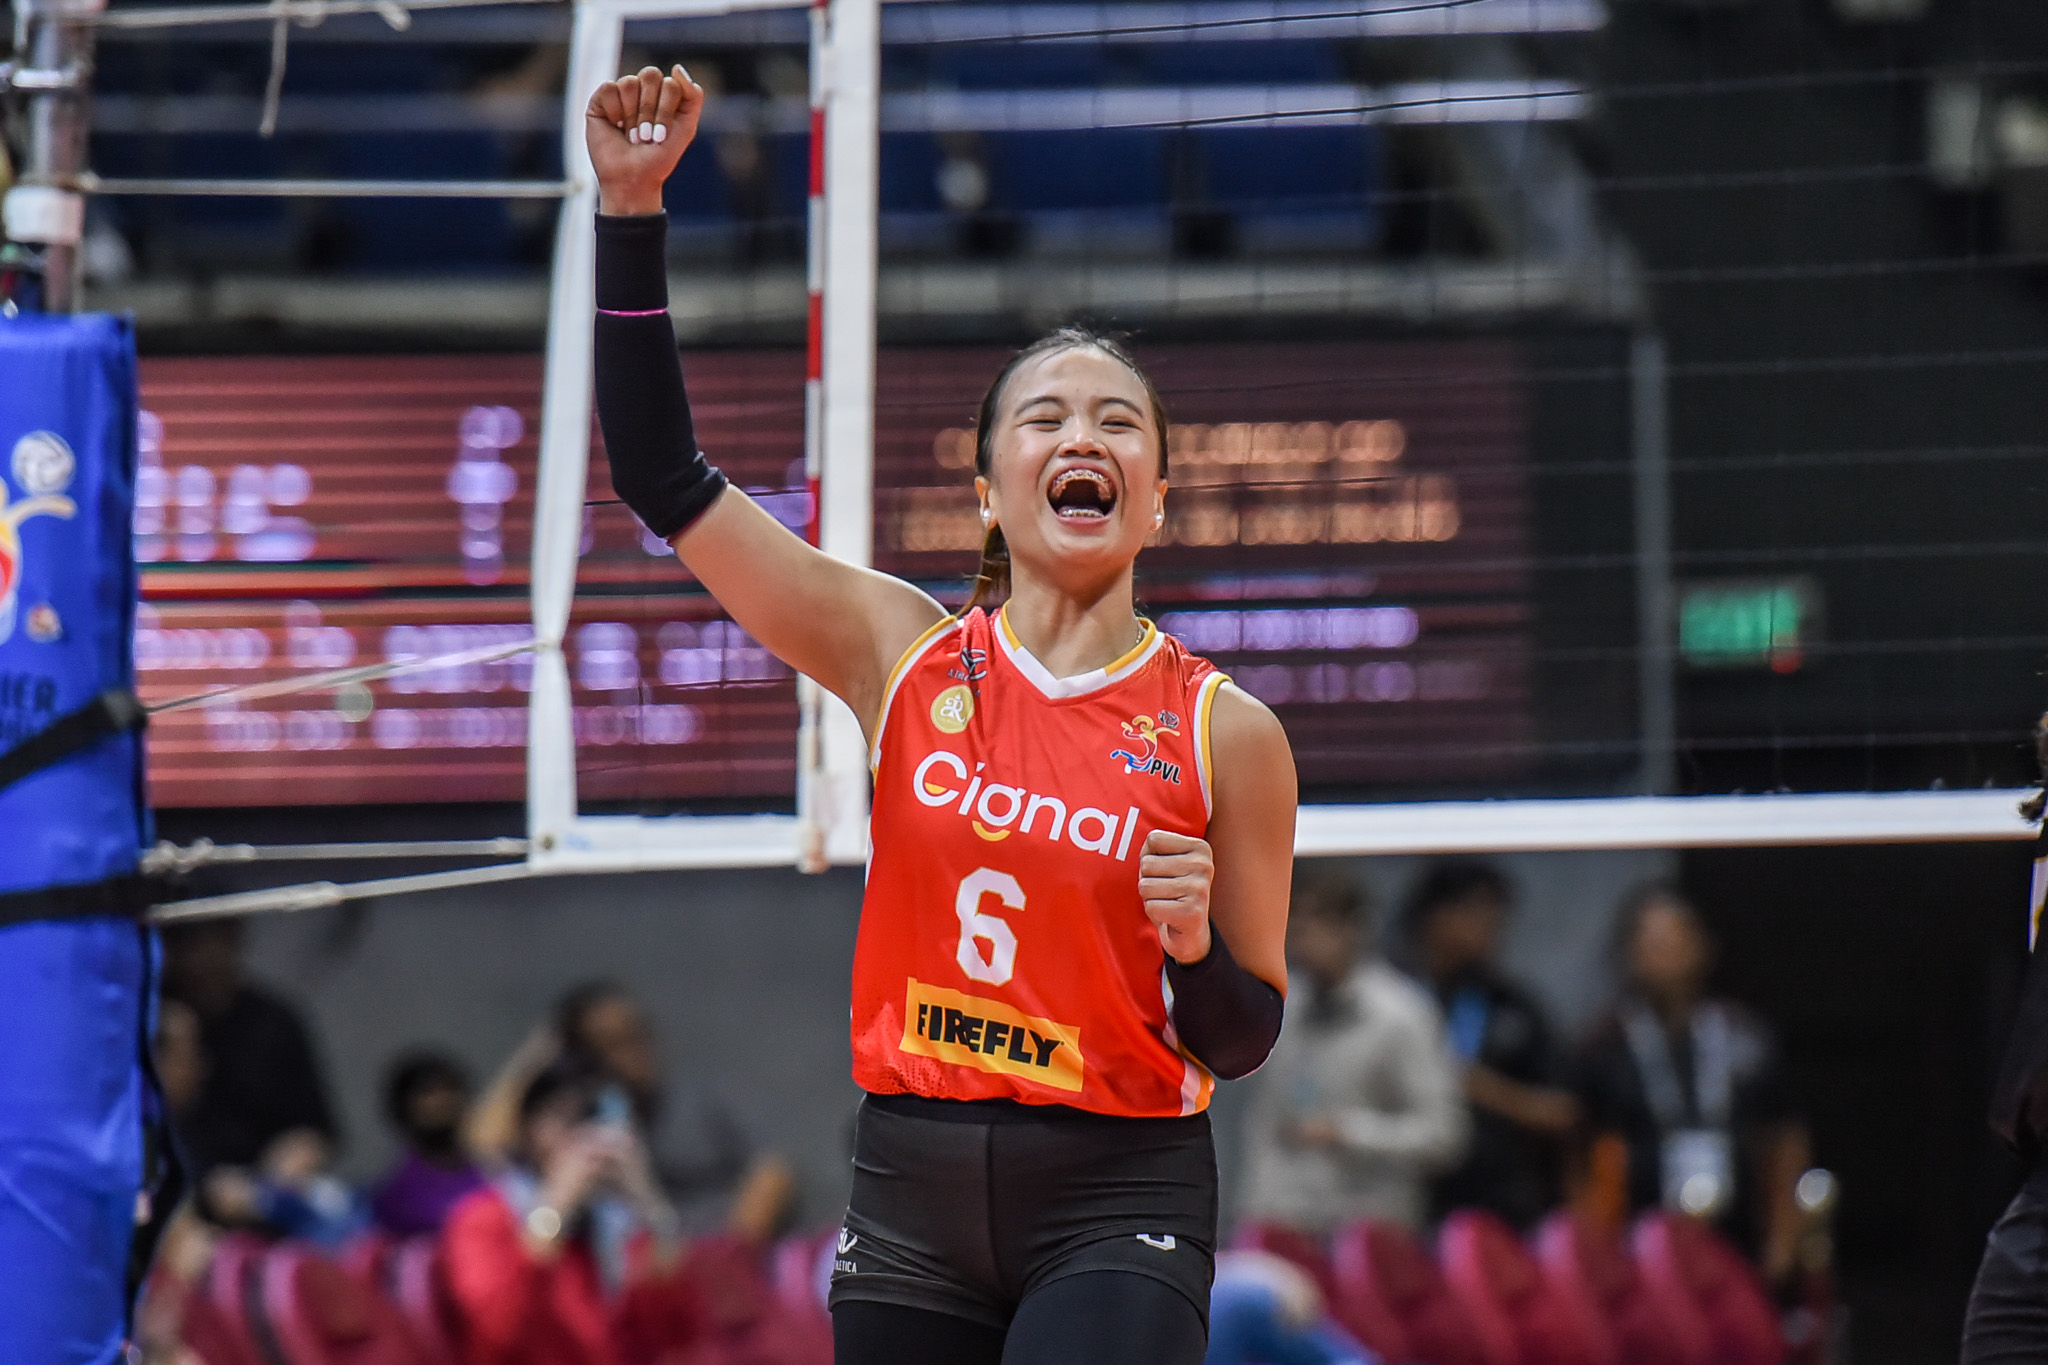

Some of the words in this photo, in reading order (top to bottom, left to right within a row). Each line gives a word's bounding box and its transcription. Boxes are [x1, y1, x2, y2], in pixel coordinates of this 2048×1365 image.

[913, 750, 1140, 862] Cignal
[1149, 758, 1181, 785] PVL
[955, 866, 1027, 987] 6
[917, 1003, 1061, 1067] FIREFLY
